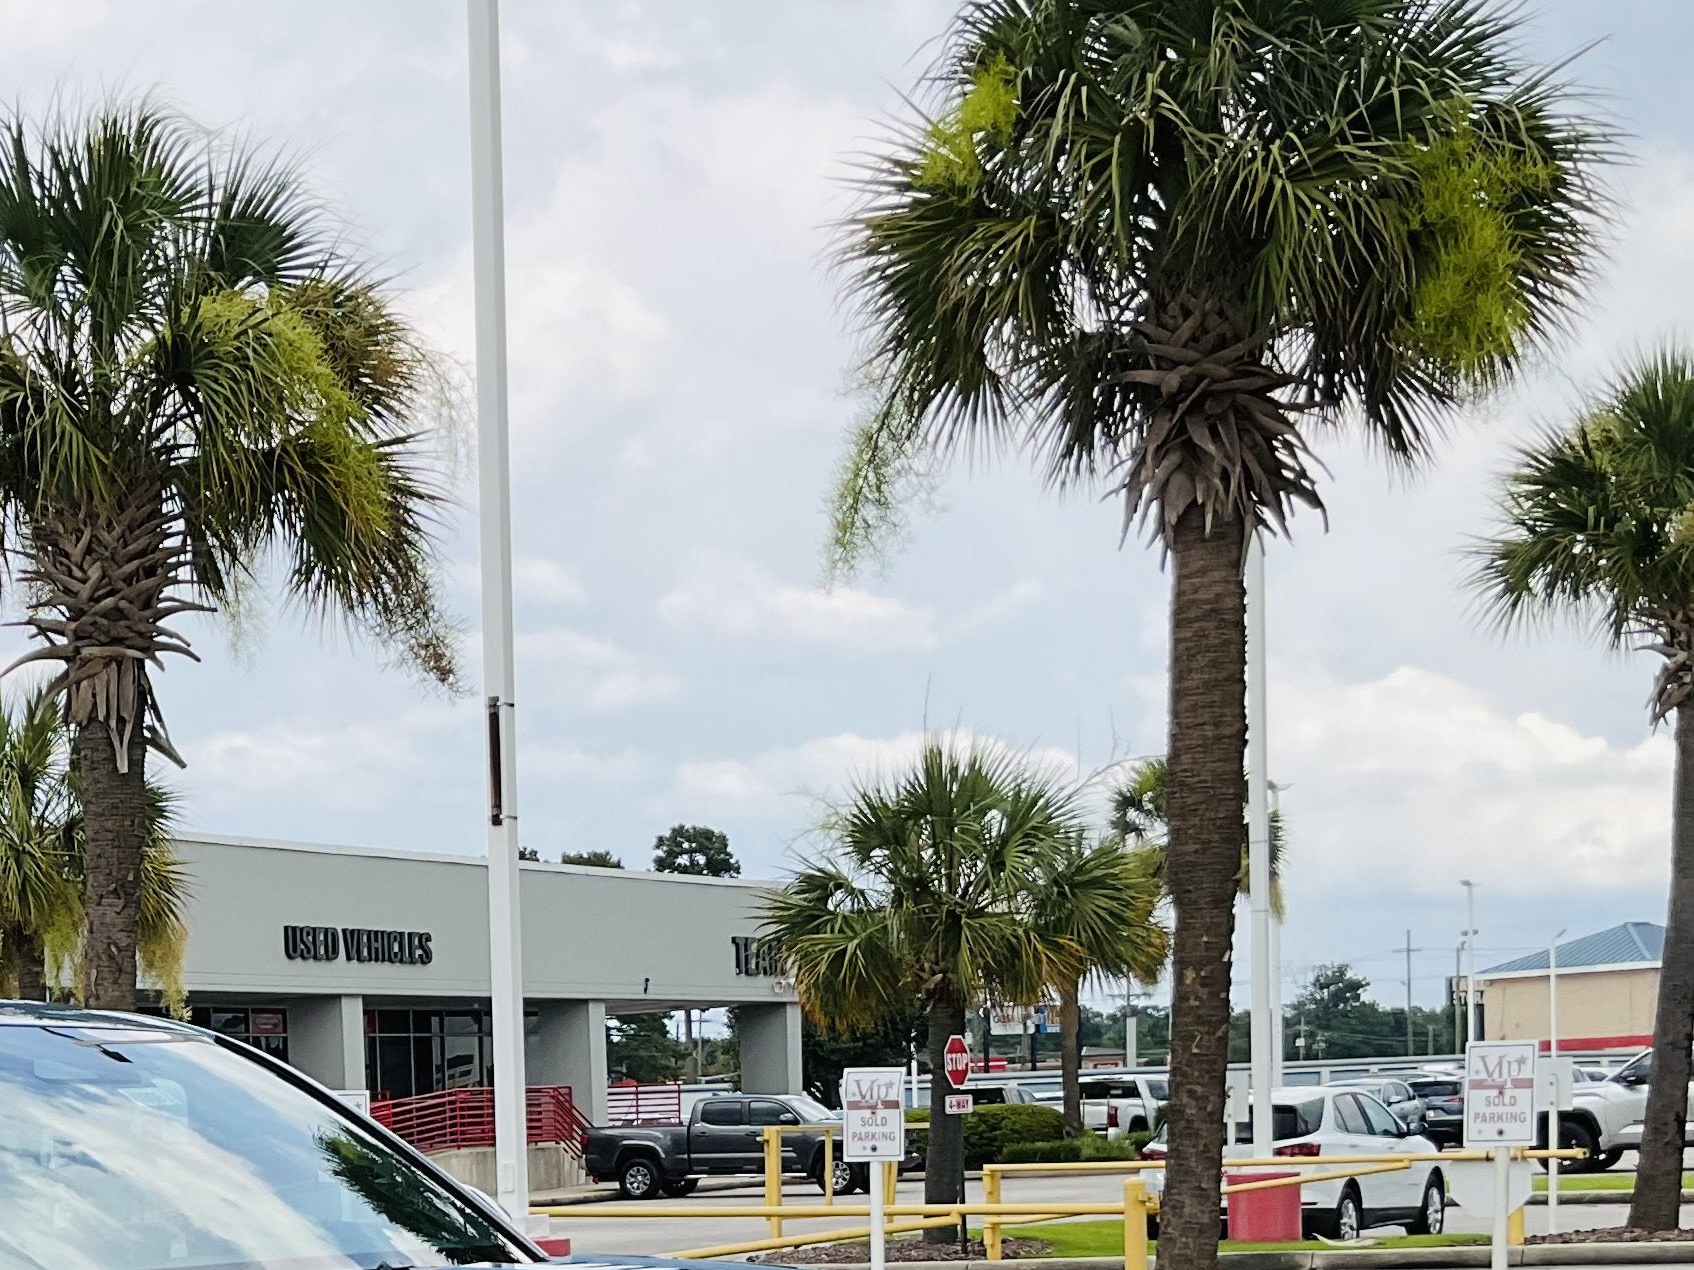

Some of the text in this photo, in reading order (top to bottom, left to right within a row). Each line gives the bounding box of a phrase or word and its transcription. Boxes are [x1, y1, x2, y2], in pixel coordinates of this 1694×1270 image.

[283, 925, 433, 965] USED VEHICLES
[946, 1053, 968, 1072] STOP
[1484, 1095, 1517, 1107] SOLD
[860, 1115, 888, 1127] SOLD
[1474, 1112, 1527, 1124] PARKING
[851, 1131, 896, 1143] PARKING
